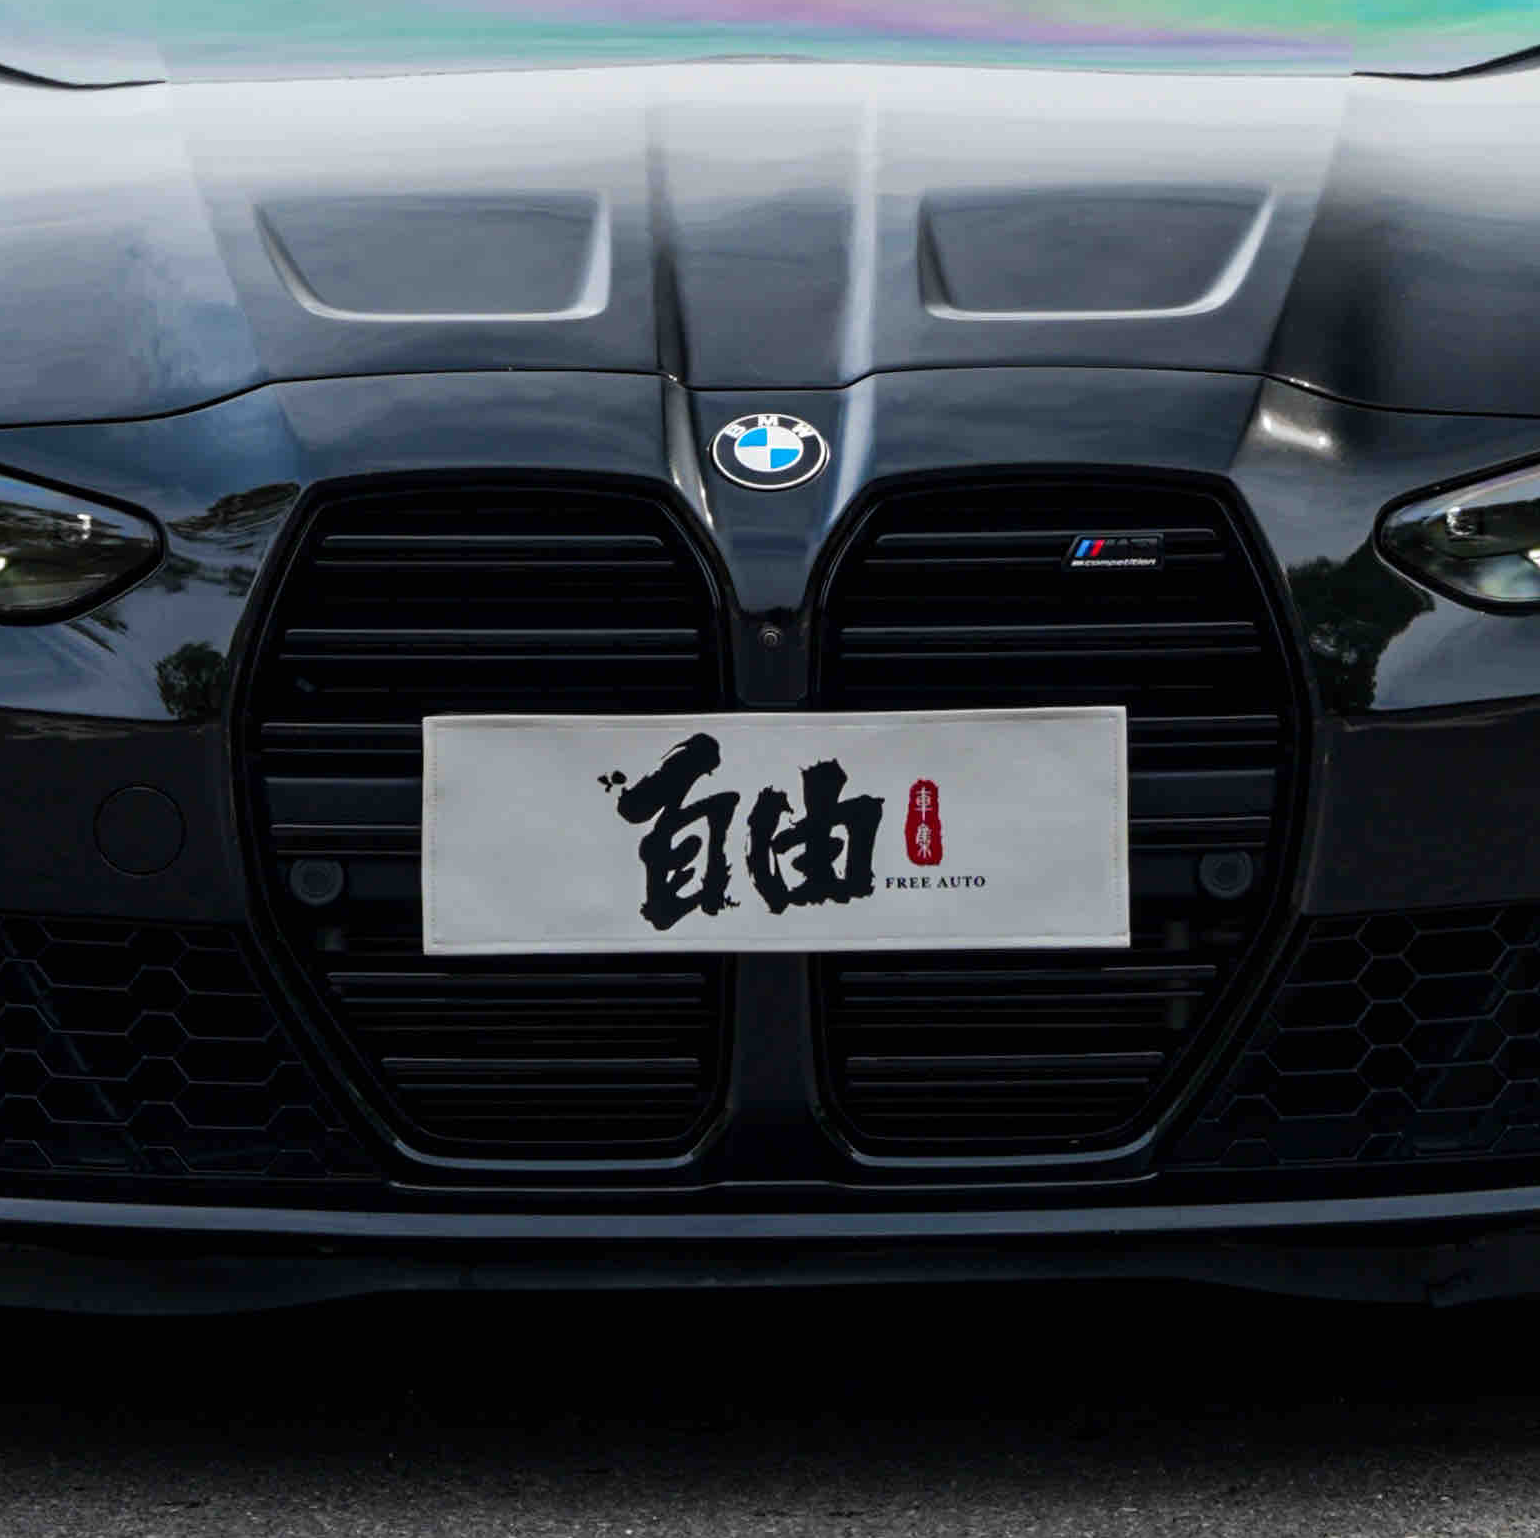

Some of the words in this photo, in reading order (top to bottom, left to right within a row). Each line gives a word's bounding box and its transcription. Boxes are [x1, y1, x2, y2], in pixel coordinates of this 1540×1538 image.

[724, 414, 815, 438] BMW
[597, 732, 885, 930] 自由
[885, 876, 931, 890] FREE
[937, 875, 987, 889] AUTO
